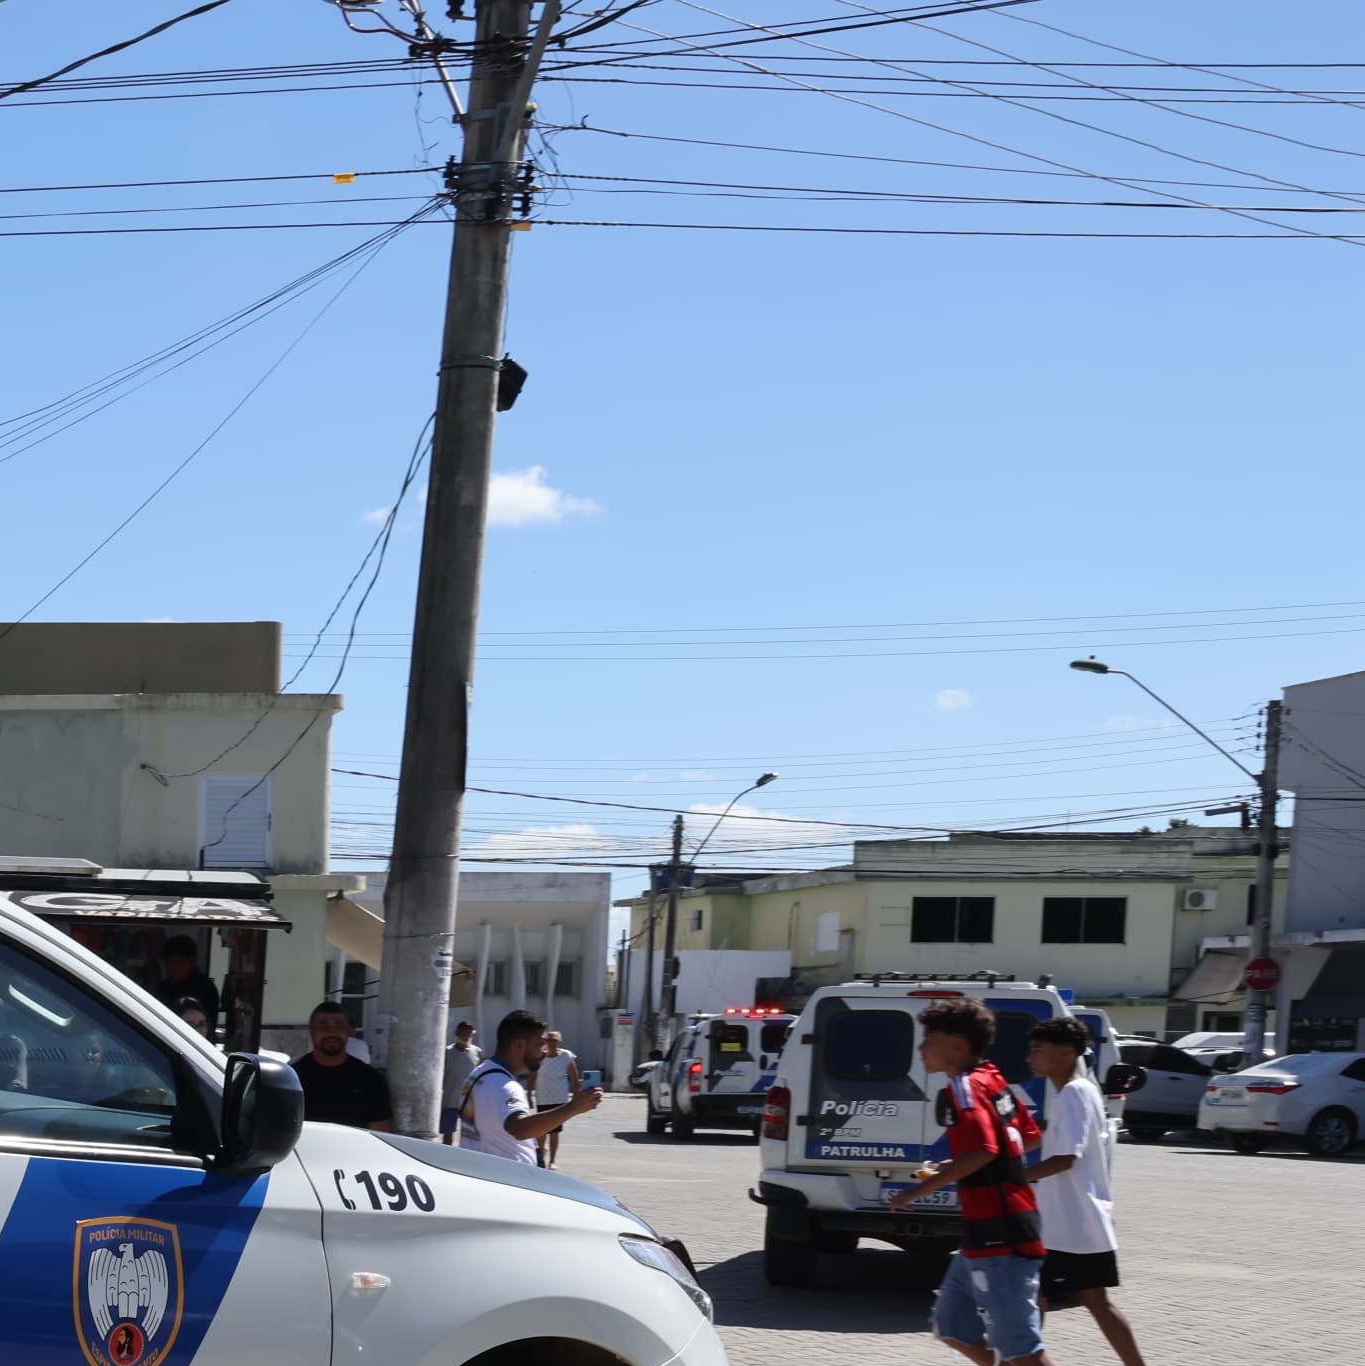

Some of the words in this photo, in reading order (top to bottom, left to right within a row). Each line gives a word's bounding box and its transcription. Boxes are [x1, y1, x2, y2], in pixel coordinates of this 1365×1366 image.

[820, 1100, 899, 1117] Polícia
[834, 1128, 862, 1137] BPM
[820, 1145, 906, 1158] PATRULHA
[354, 1170, 436, 1213] 190
[89, 1227, 127, 1244] POLÍCIA
[127, 1230, 166, 1246] MILITAR
